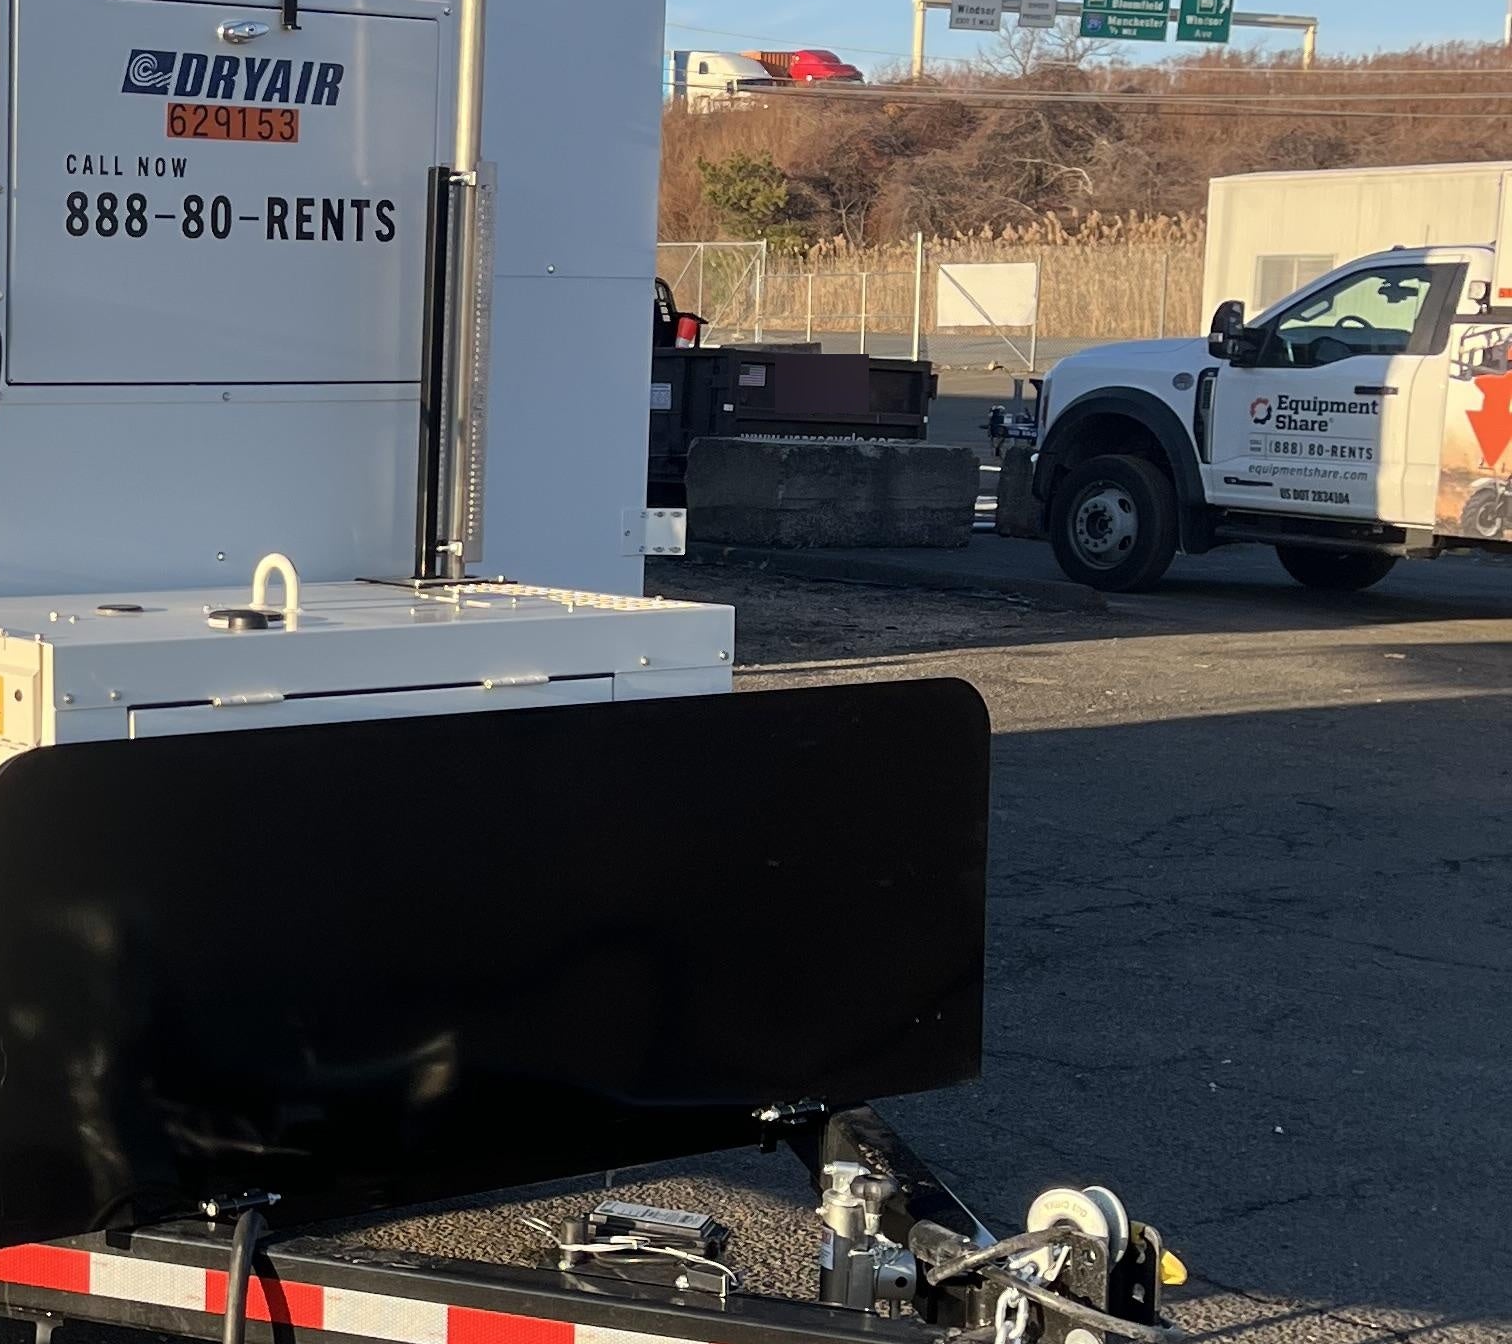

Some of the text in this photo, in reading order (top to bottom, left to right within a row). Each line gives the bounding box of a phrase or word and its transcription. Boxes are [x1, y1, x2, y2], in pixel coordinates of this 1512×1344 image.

[957, 4, 997, 16] Windsor
[1106, 14, 1166, 29] Manchester
[1185, 14, 1225, 27] Windsor
[172, 52, 345, 107] DRYAIR
[169, 103, 296, 141] 629153
[66, 154, 188, 178] CALL NOW
[65, 191, 396, 243] 888-80-RENTS
[1276, 394, 1379, 416] Equipment
[1275, 413, 1329, 432] Share
[1268, 440, 1374, 460] (888) 80-RENTS
[1248, 462, 1368, 481] equipmentshare.com
[1279, 487, 1292, 500] US
[1292, 488, 1310, 502] DOT
